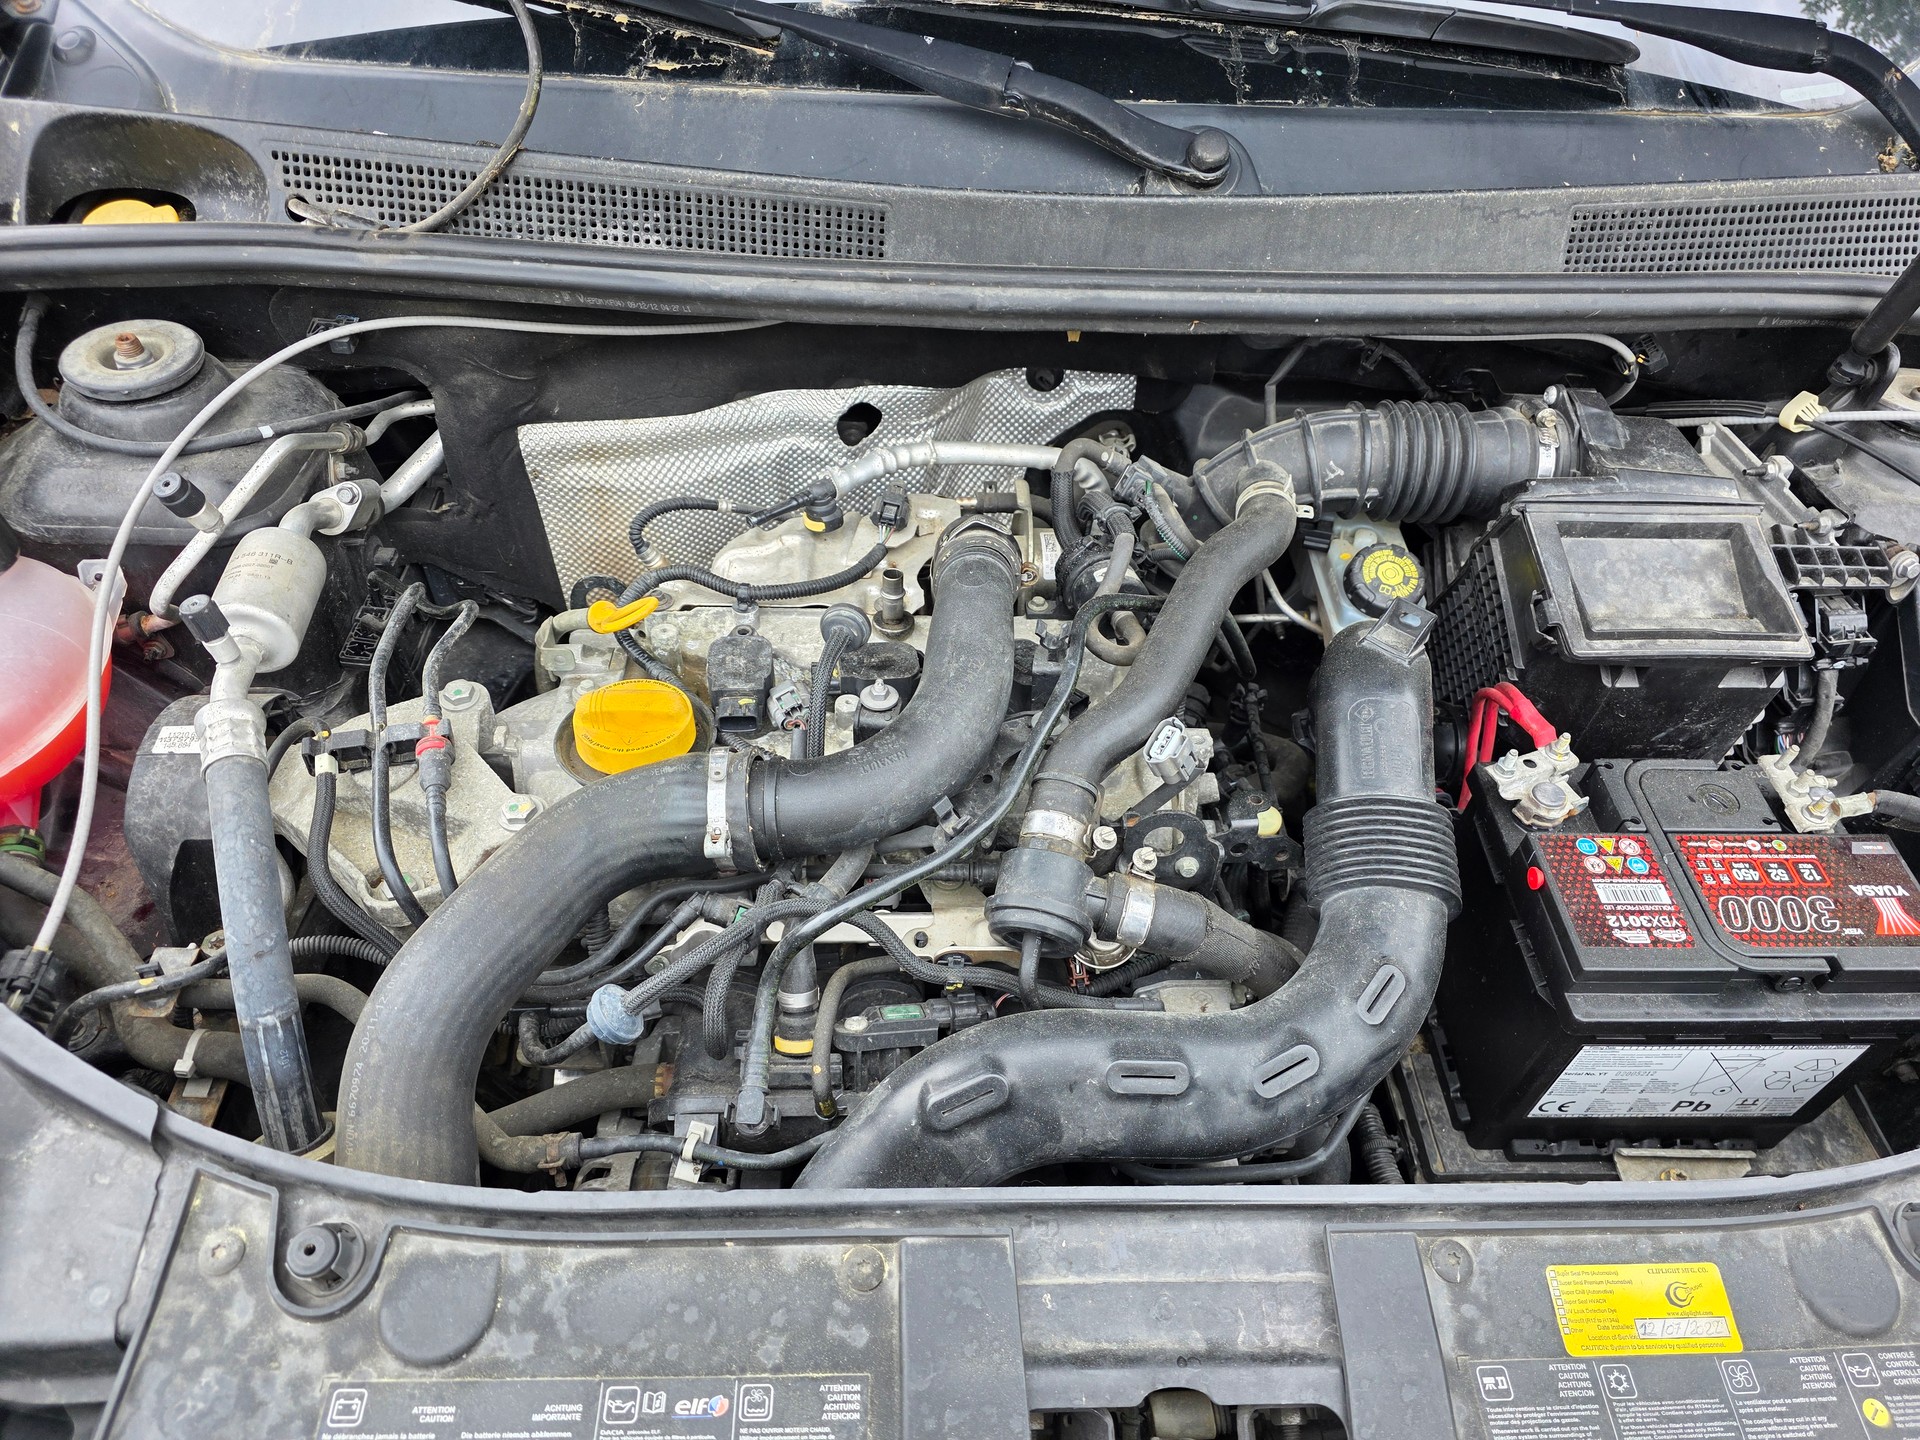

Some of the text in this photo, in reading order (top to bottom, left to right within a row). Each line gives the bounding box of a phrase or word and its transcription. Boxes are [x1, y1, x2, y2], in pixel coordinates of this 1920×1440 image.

[1360, 723, 1374, 779] RENAULT
[1734, 869, 1760, 881] 450
[1767, 868, 1791, 881] 52
[1800, 868, 1822, 881] 12
[1849, 885, 1910, 896] YUASA
[1718, 896, 1839, 932] 3000
[1606, 915, 1682, 927] YBX3012
[349, 1061, 364, 1117] 6670974
[1538, 1101, 1576, 1112] CE
[1670, 1100, 1712, 1112] Pb
[346, 1124, 355, 1155] AVON
[1878, 1351, 1915, 1359] CONTROLE
[1790, 1356, 1826, 1364] ATTENTION
[1886, 1360, 1919, 1368] CONTROL
[1549, 1363, 1586, 1371] ATTENTION
[1881, 1369, 1920, 1377] KONTROLLE
[819, 1384, 860, 1392] ATTENTION
[412, 1405, 456, 1414] ATTENTION
[544, 1404, 583, 1412] ACHTUNG
[674, 1398, 710, 1414] elf
[420, 1414, 454, 1423] CAUTION
[532, 1413, 581, 1421] IMPORTANTE
[821, 1412, 860, 1420] ATENCION
[375, 1432, 398, 1440] jamais
[474, 1431, 500, 1439] batterie
